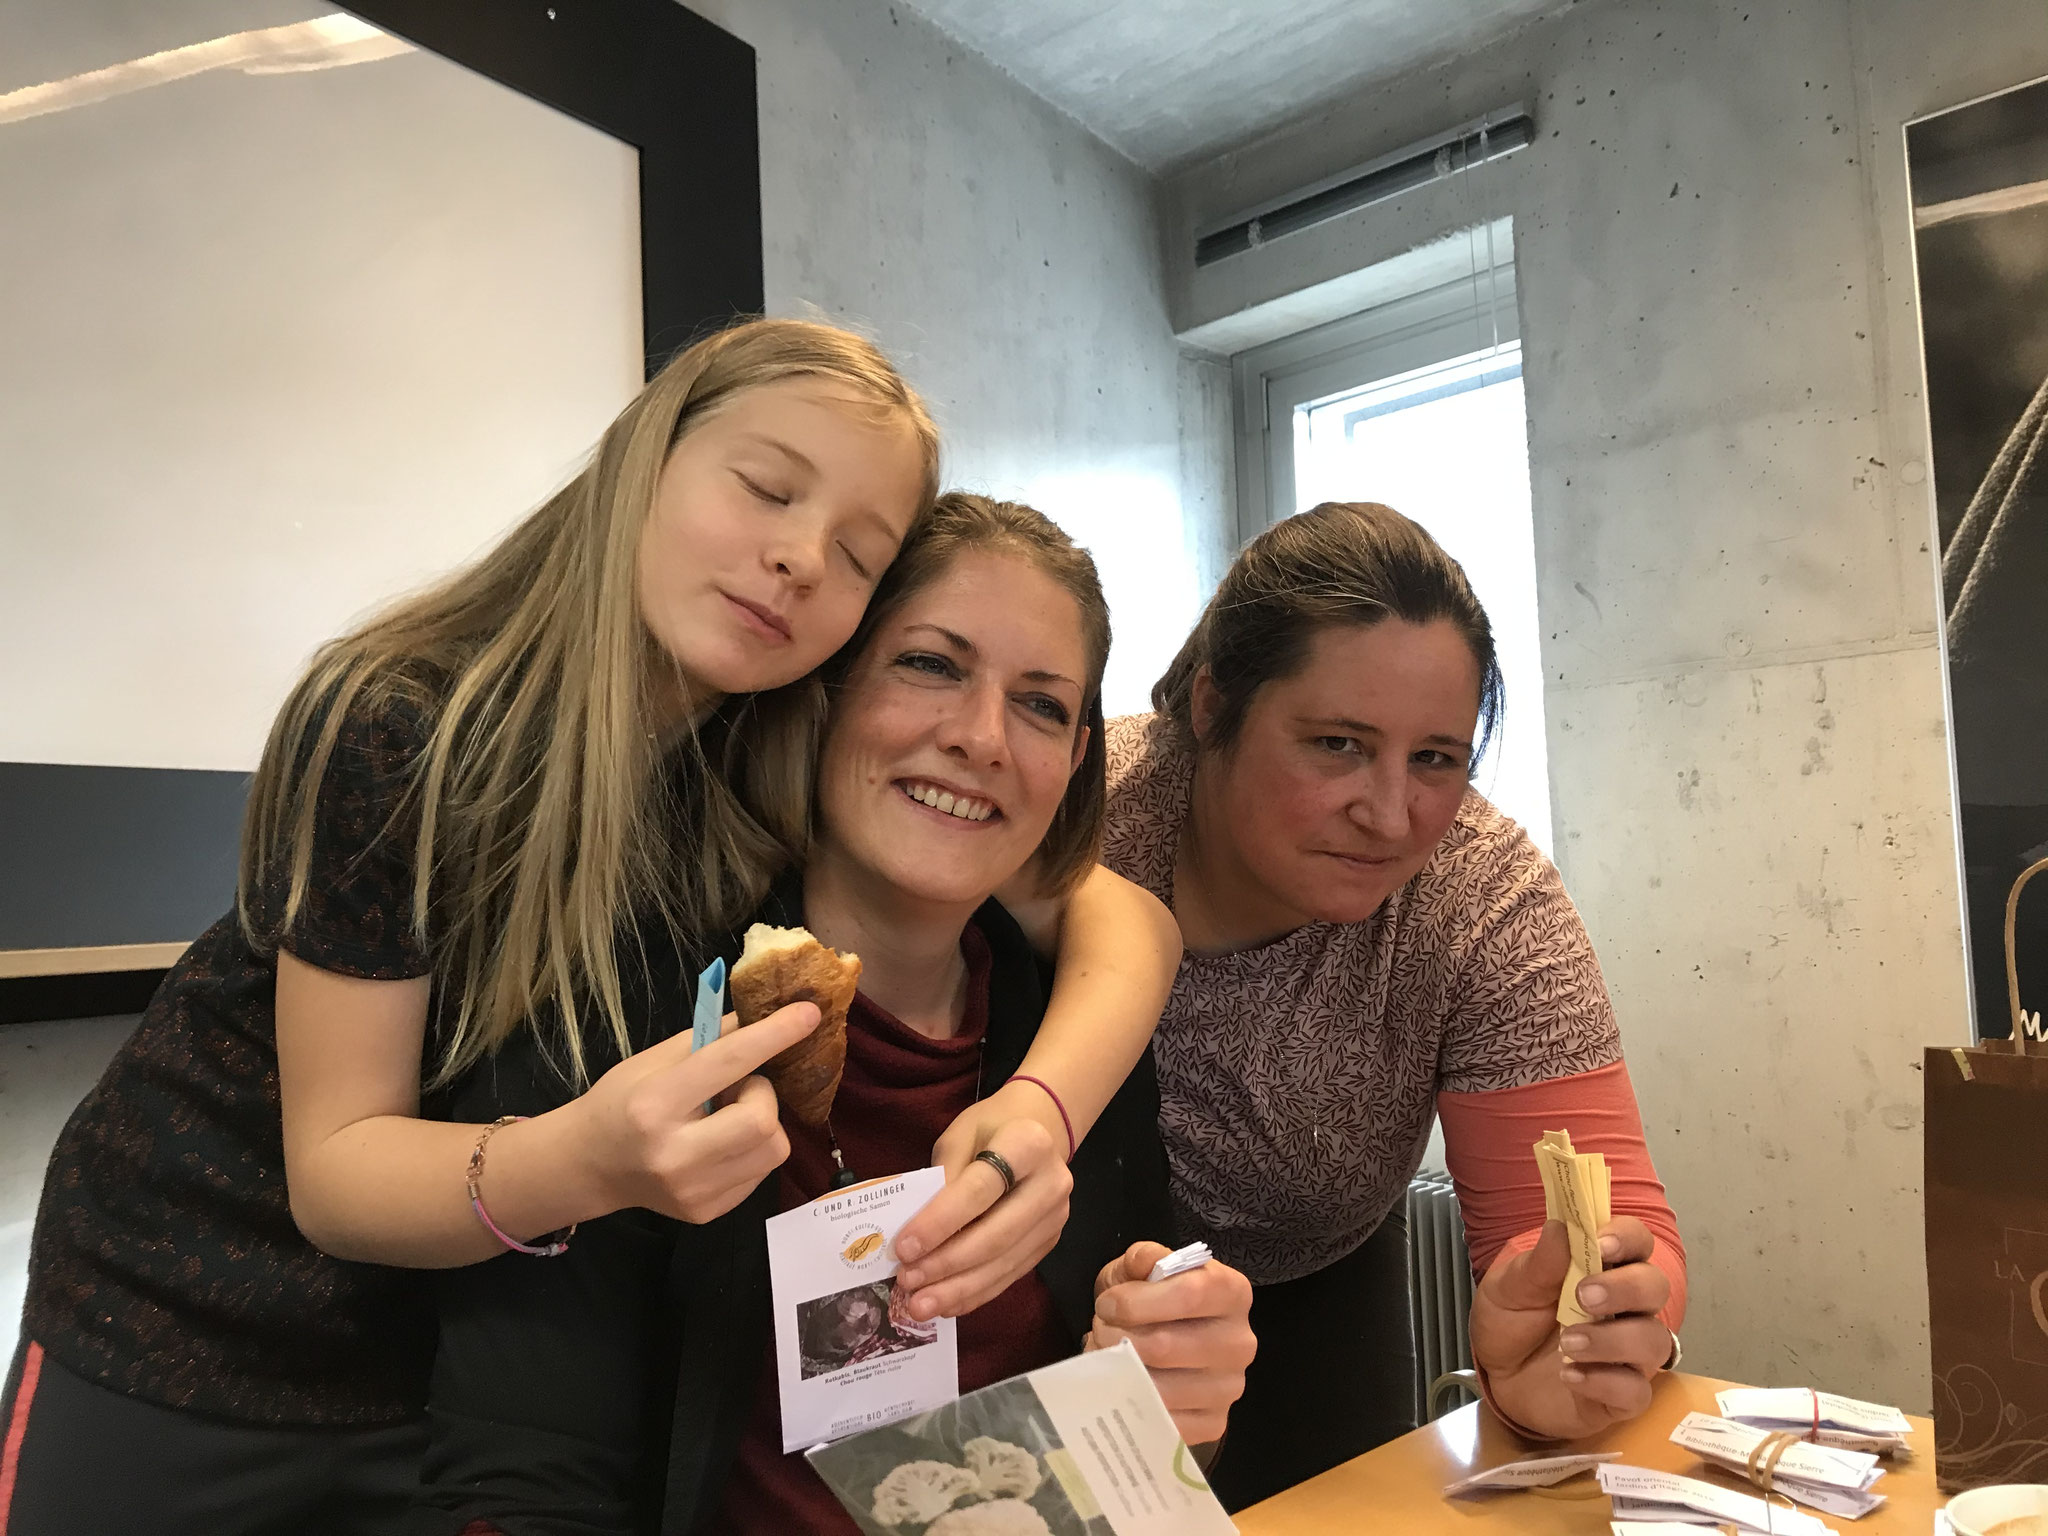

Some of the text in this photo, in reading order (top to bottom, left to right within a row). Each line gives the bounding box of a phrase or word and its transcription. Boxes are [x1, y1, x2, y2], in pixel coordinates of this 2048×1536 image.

[824, 1202, 842, 1214] UND
[859, 1183, 905, 1204] ZOLLINGER
[869, 1200, 891, 1211] Samen
[866, 1410, 881, 1422] BIO
[1799, 1460, 1825, 1474] Sierre
